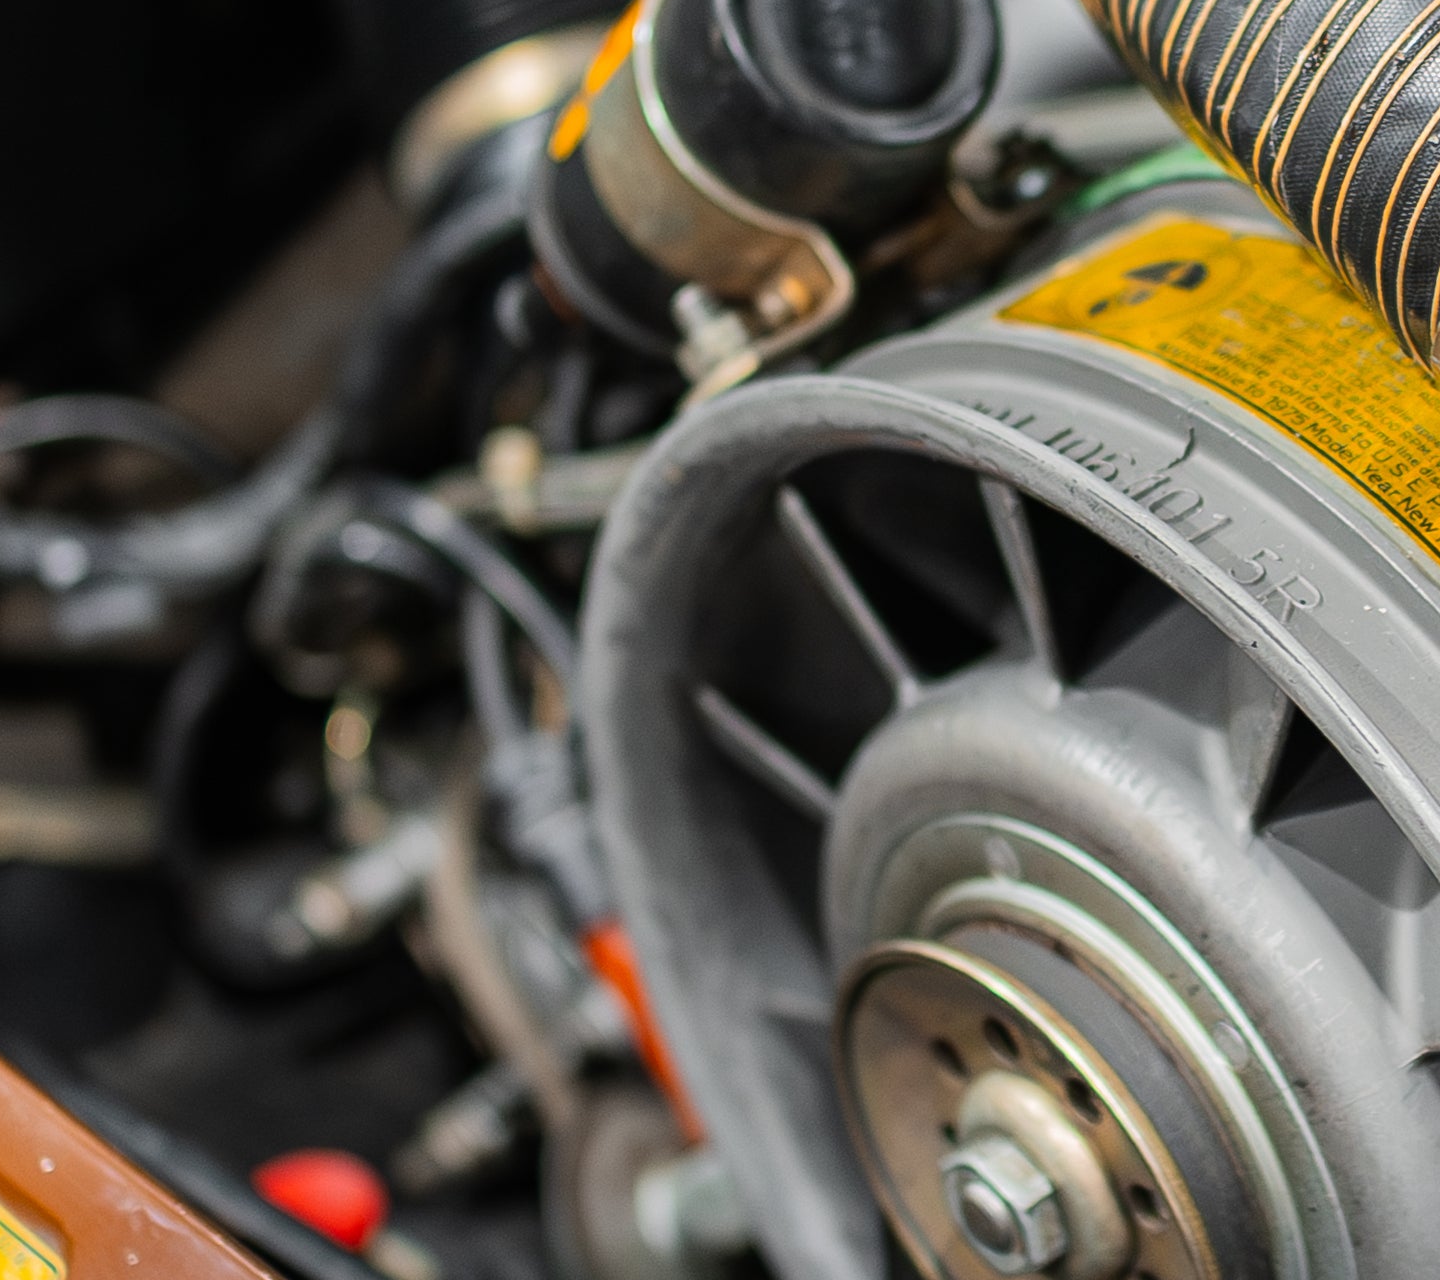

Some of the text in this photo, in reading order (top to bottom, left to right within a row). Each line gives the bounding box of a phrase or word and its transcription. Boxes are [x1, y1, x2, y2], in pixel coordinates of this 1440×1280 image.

[1268, 374, 1351, 434] conforms
[1351, 429, 1373, 451] to
[1266, 393, 1308, 428] 1975
[1304, 417, 1362, 466] Model
[1360, 462, 1401, 500] Year
[1397, 494, 1440, 536] New
[1395, 443, 1420, 467] line
[1399, 428, 1432, 458] RPM
